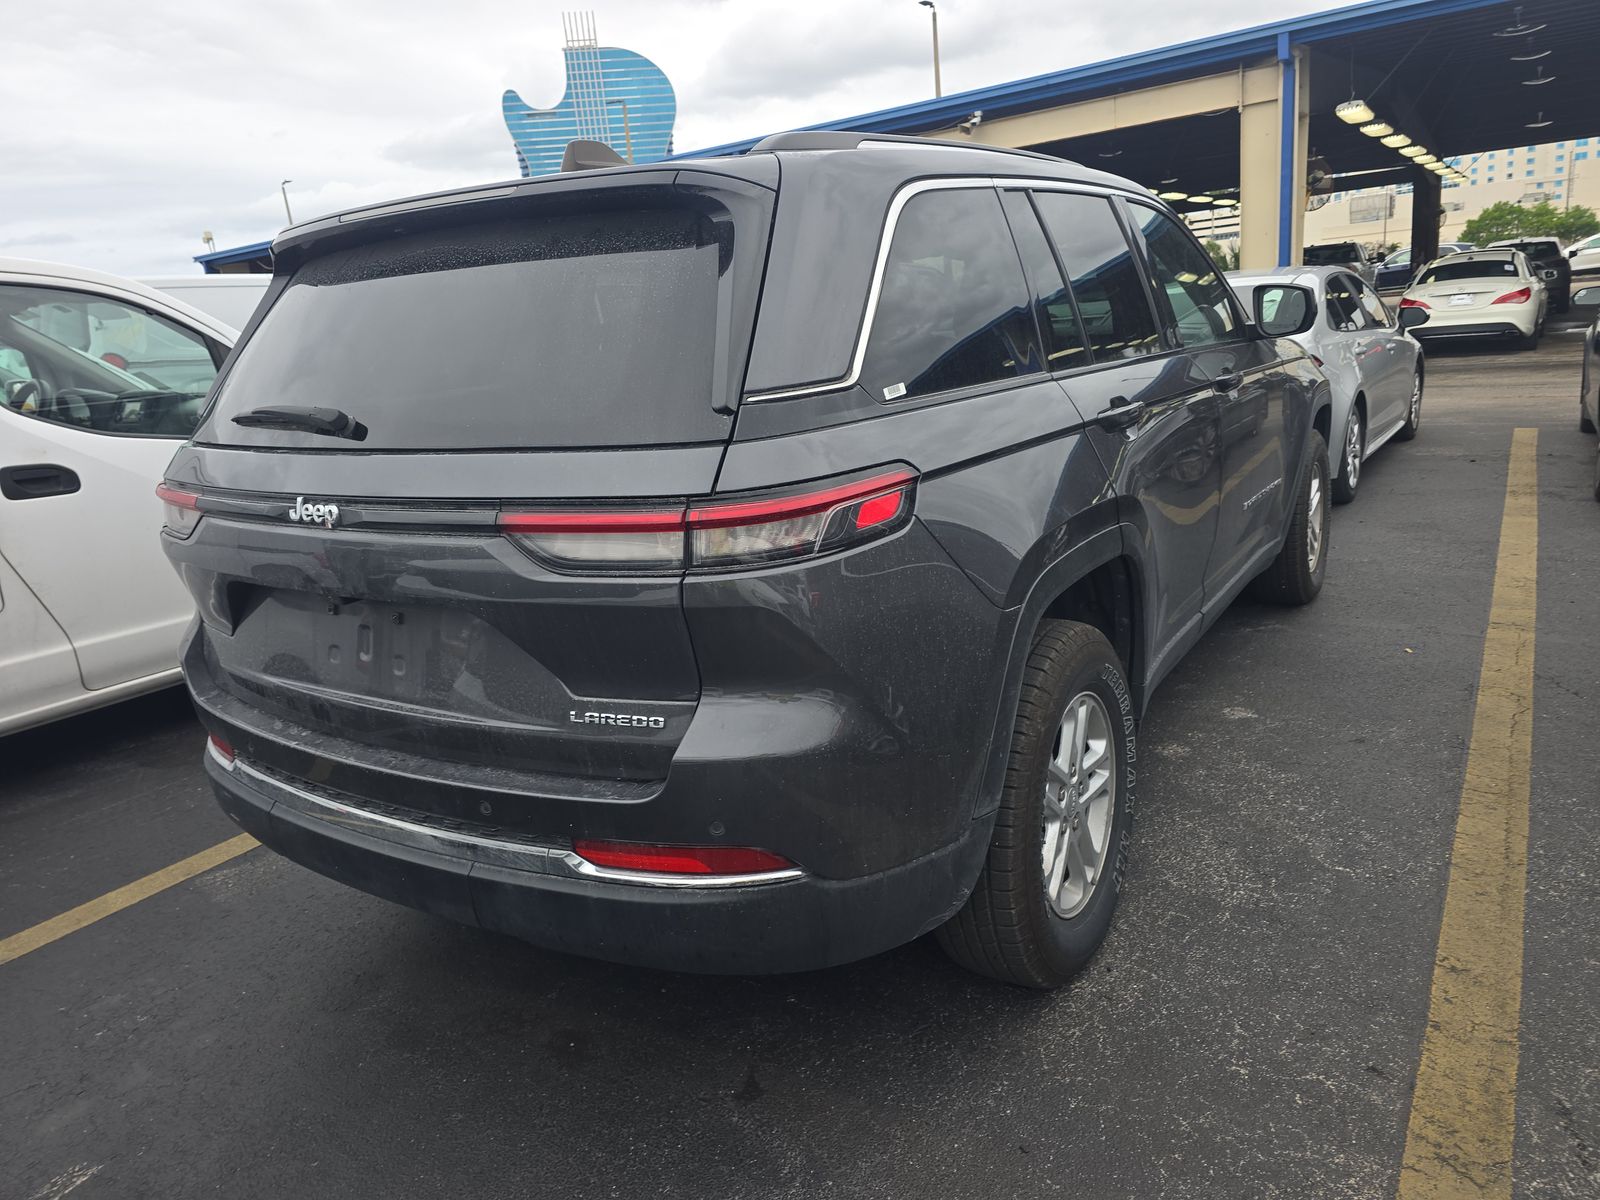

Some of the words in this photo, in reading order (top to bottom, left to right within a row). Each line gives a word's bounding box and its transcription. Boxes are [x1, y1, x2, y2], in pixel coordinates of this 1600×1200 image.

[289, 497, 339, 528] Jeep
[569, 710, 665, 729] LAREDO
[1102, 663, 1137, 814] TERRAMAX
